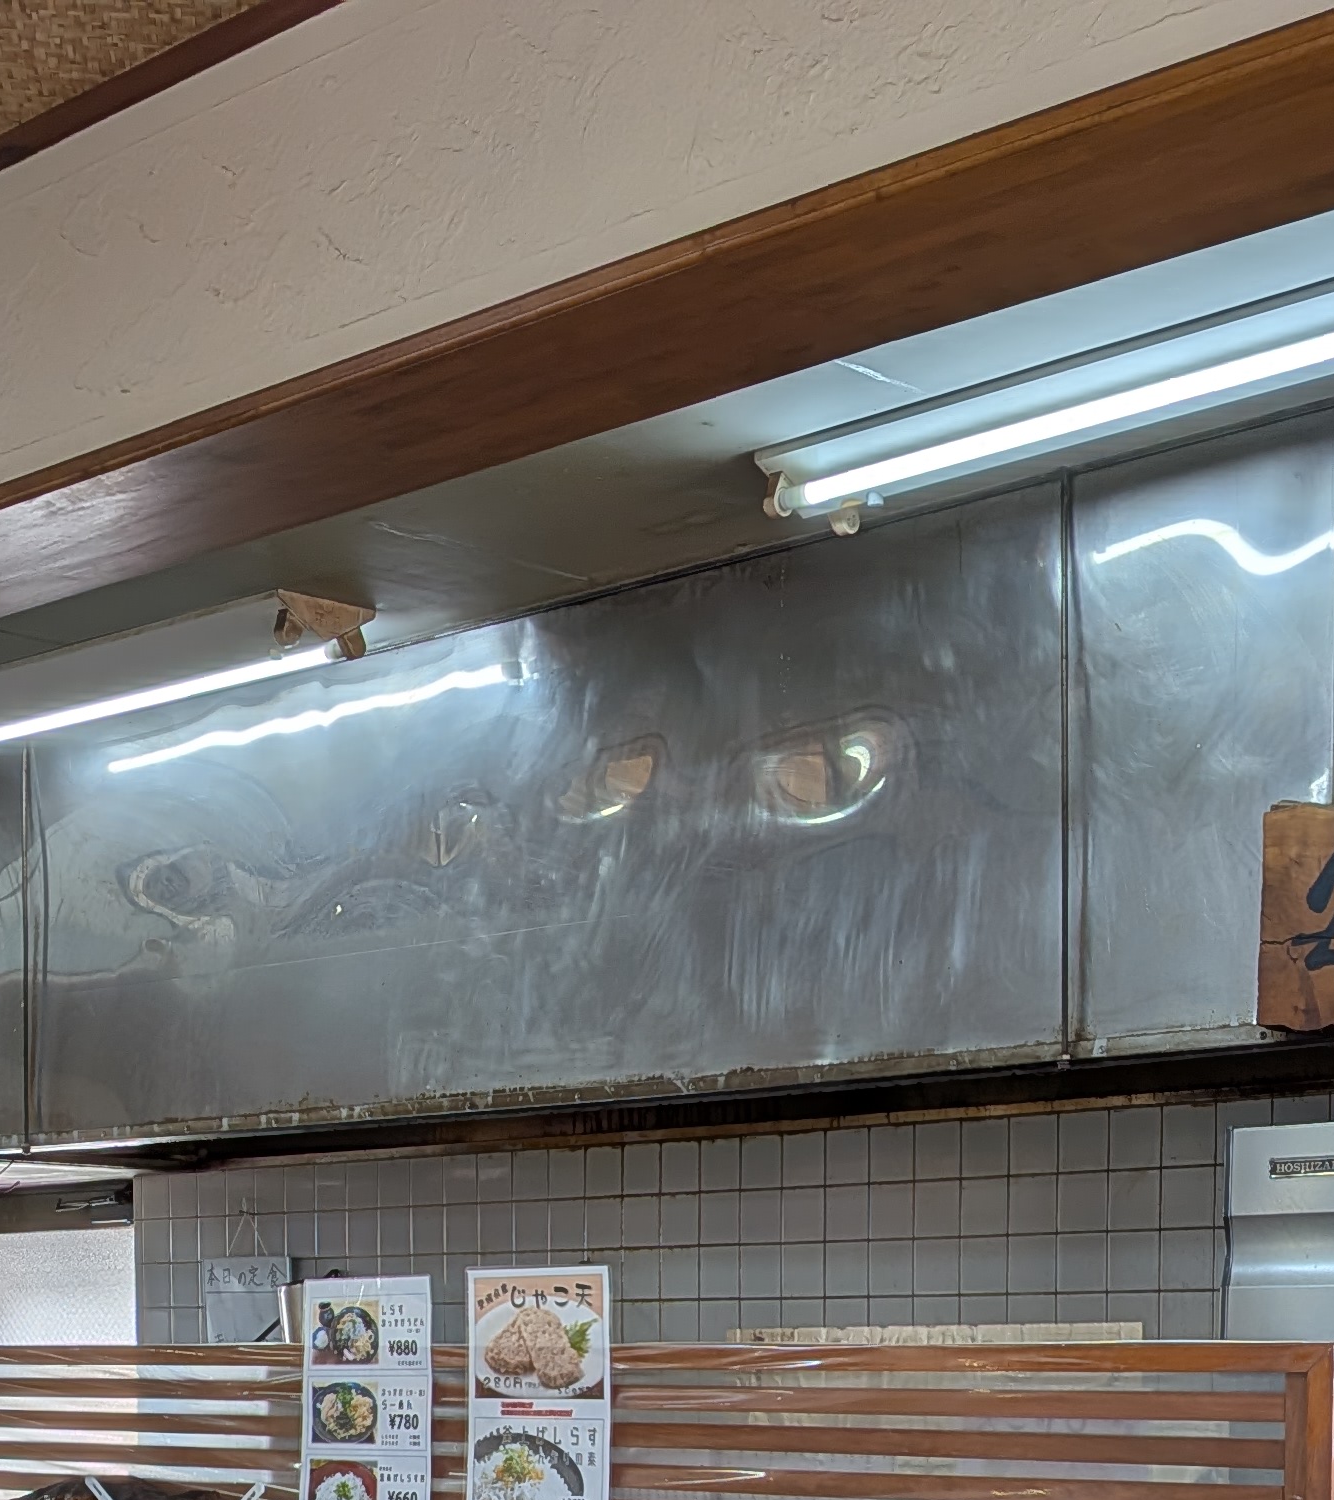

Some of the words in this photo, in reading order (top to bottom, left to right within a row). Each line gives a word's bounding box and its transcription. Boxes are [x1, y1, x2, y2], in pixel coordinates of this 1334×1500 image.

[207, 1262, 288, 1288] 本日の定食
[511, 1283, 593, 1309] じゃこ天
[388, 1339, 418, 1356] ¥880
[388, 1413, 419, 1430] ¥780
[501, 1425, 597, 1446] 釜上げしらす
